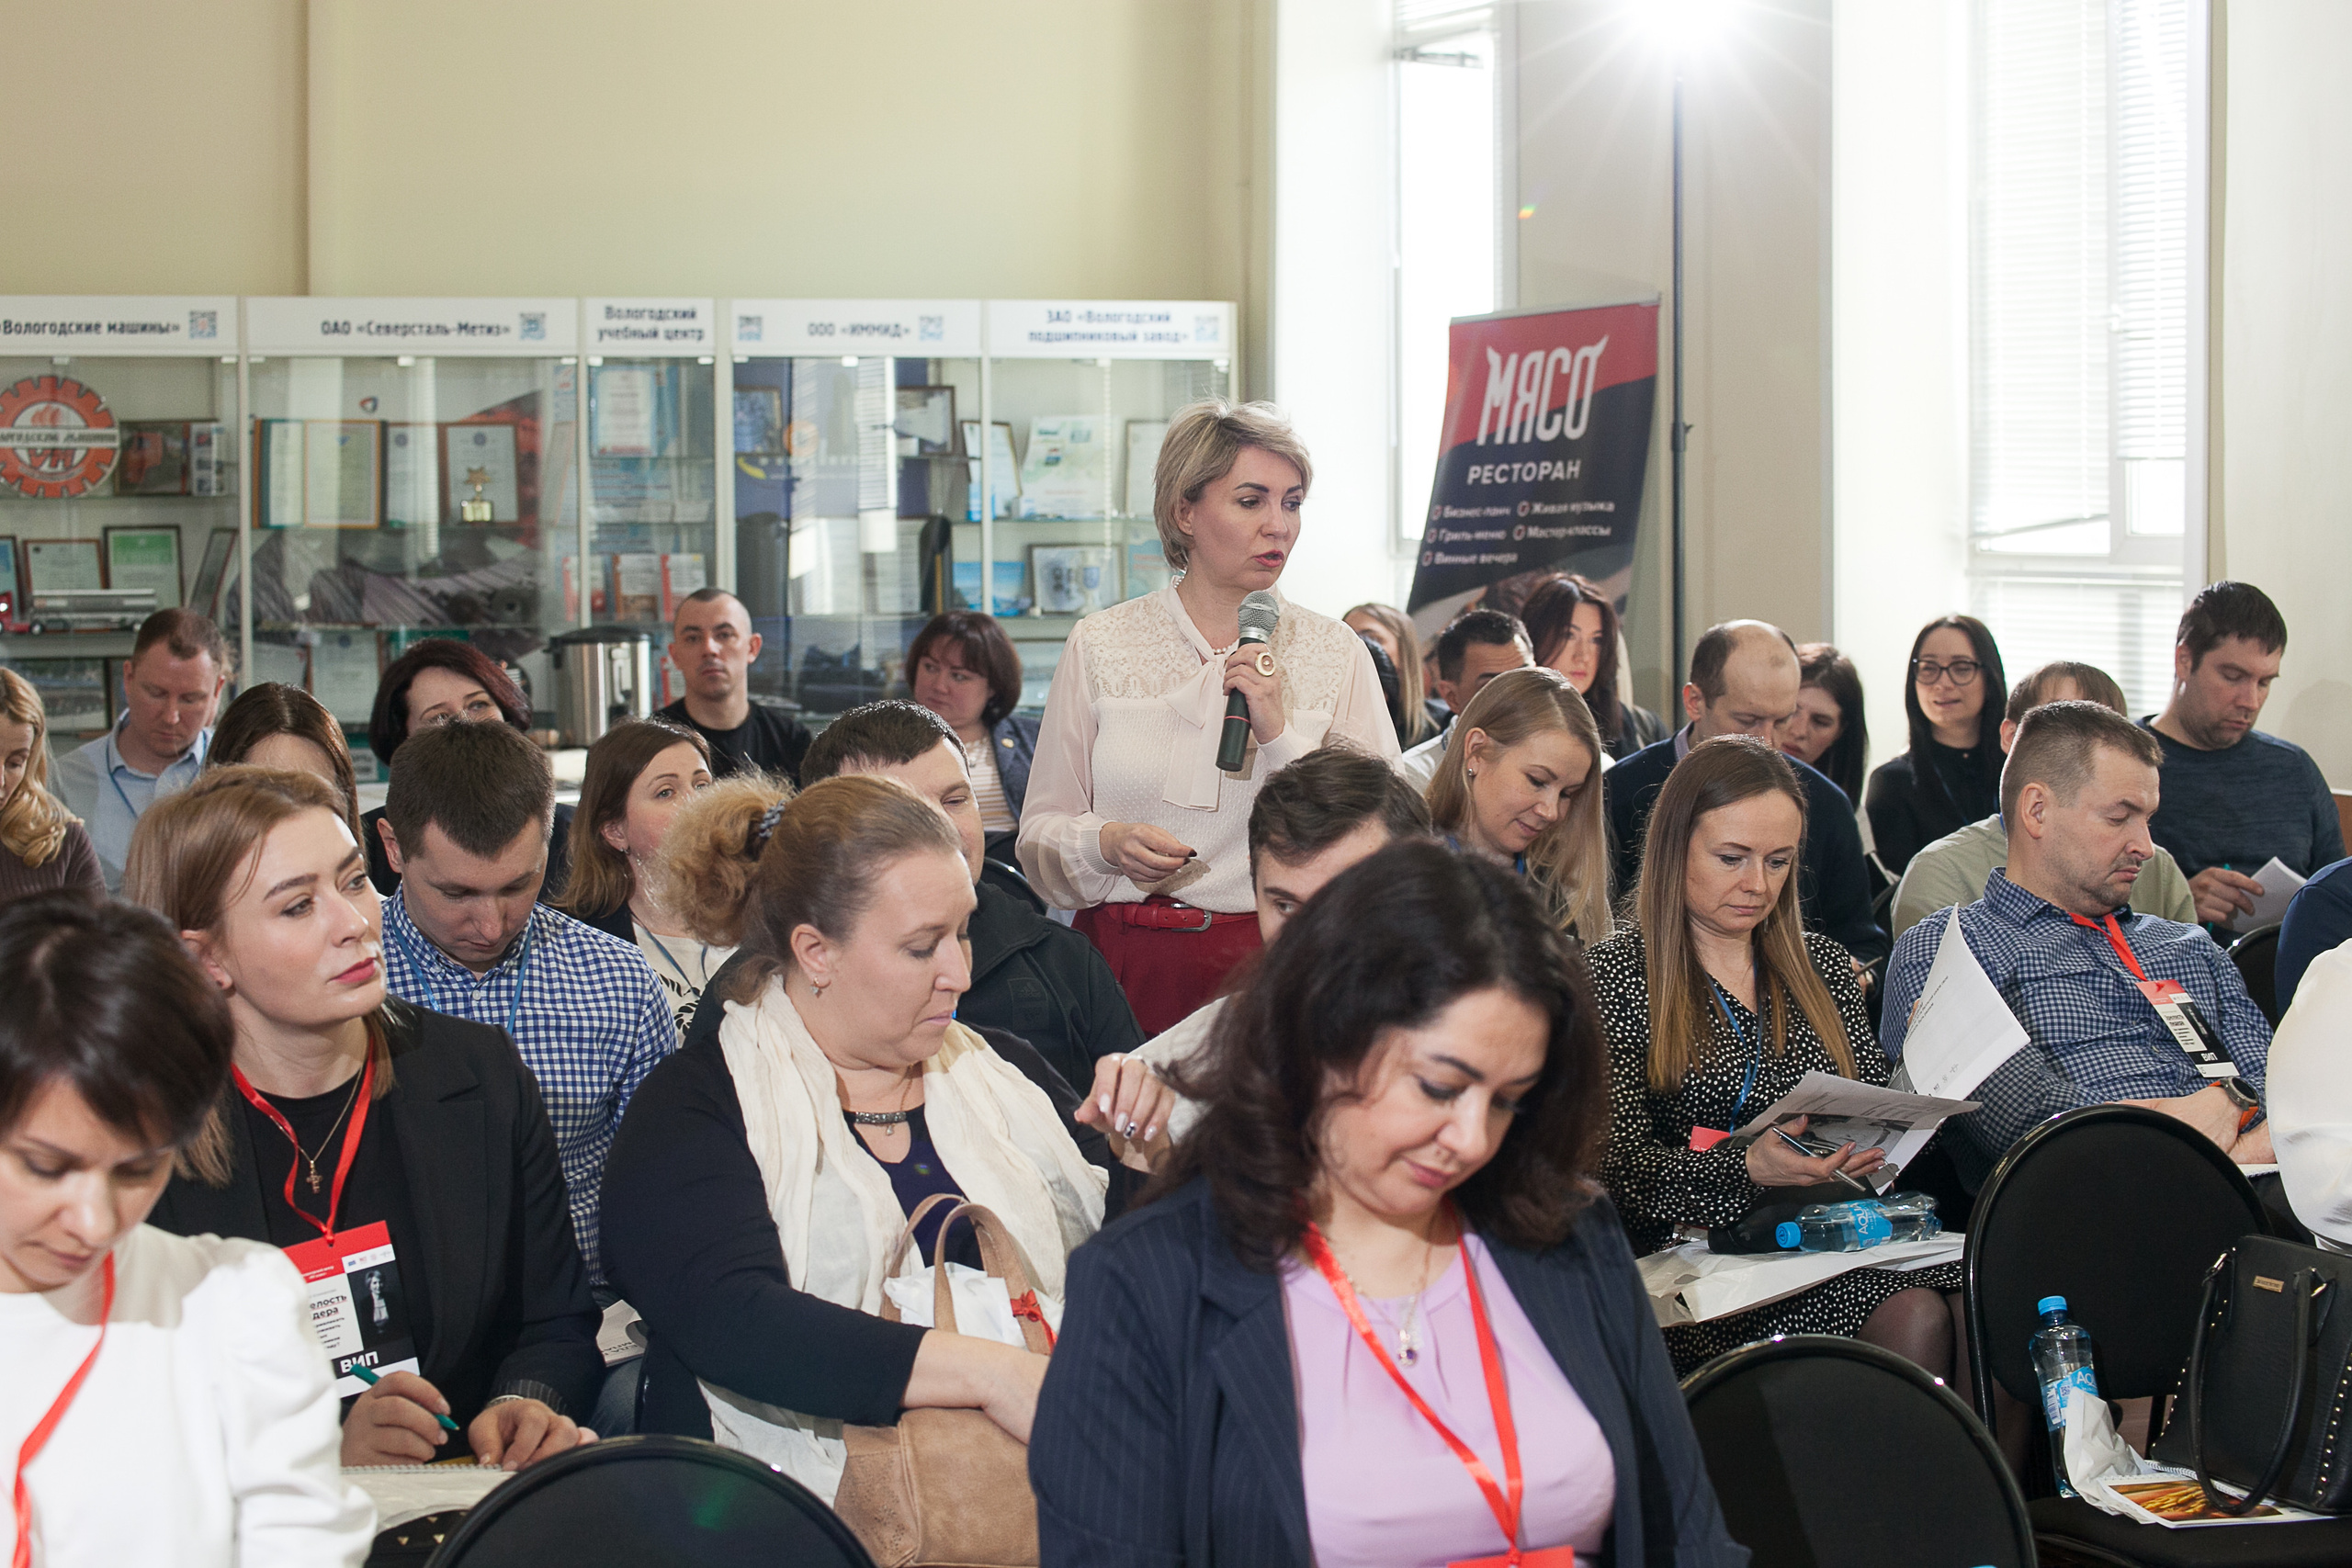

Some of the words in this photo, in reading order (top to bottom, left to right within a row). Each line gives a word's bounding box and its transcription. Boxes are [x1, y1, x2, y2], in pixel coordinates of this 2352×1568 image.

[605, 306, 696, 321] Вологодский
[1047, 310, 1071, 322] ЗАО
[0, 320, 102, 337] Вологодские
[107, 321, 180, 334] машины»
[322, 321, 351, 334] ОАО
[357, 321, 510, 337] «Северсталь-Метиз»
[598, 327, 659, 342] учебный
[664, 330, 704, 342] центр
[808, 322, 835, 335] ООО
[1029, 332, 1137, 343] подшипниковый
[1476, 334, 1610, 446] МЯСО
[1467, 460, 1581, 485] РЕСТОРАН
